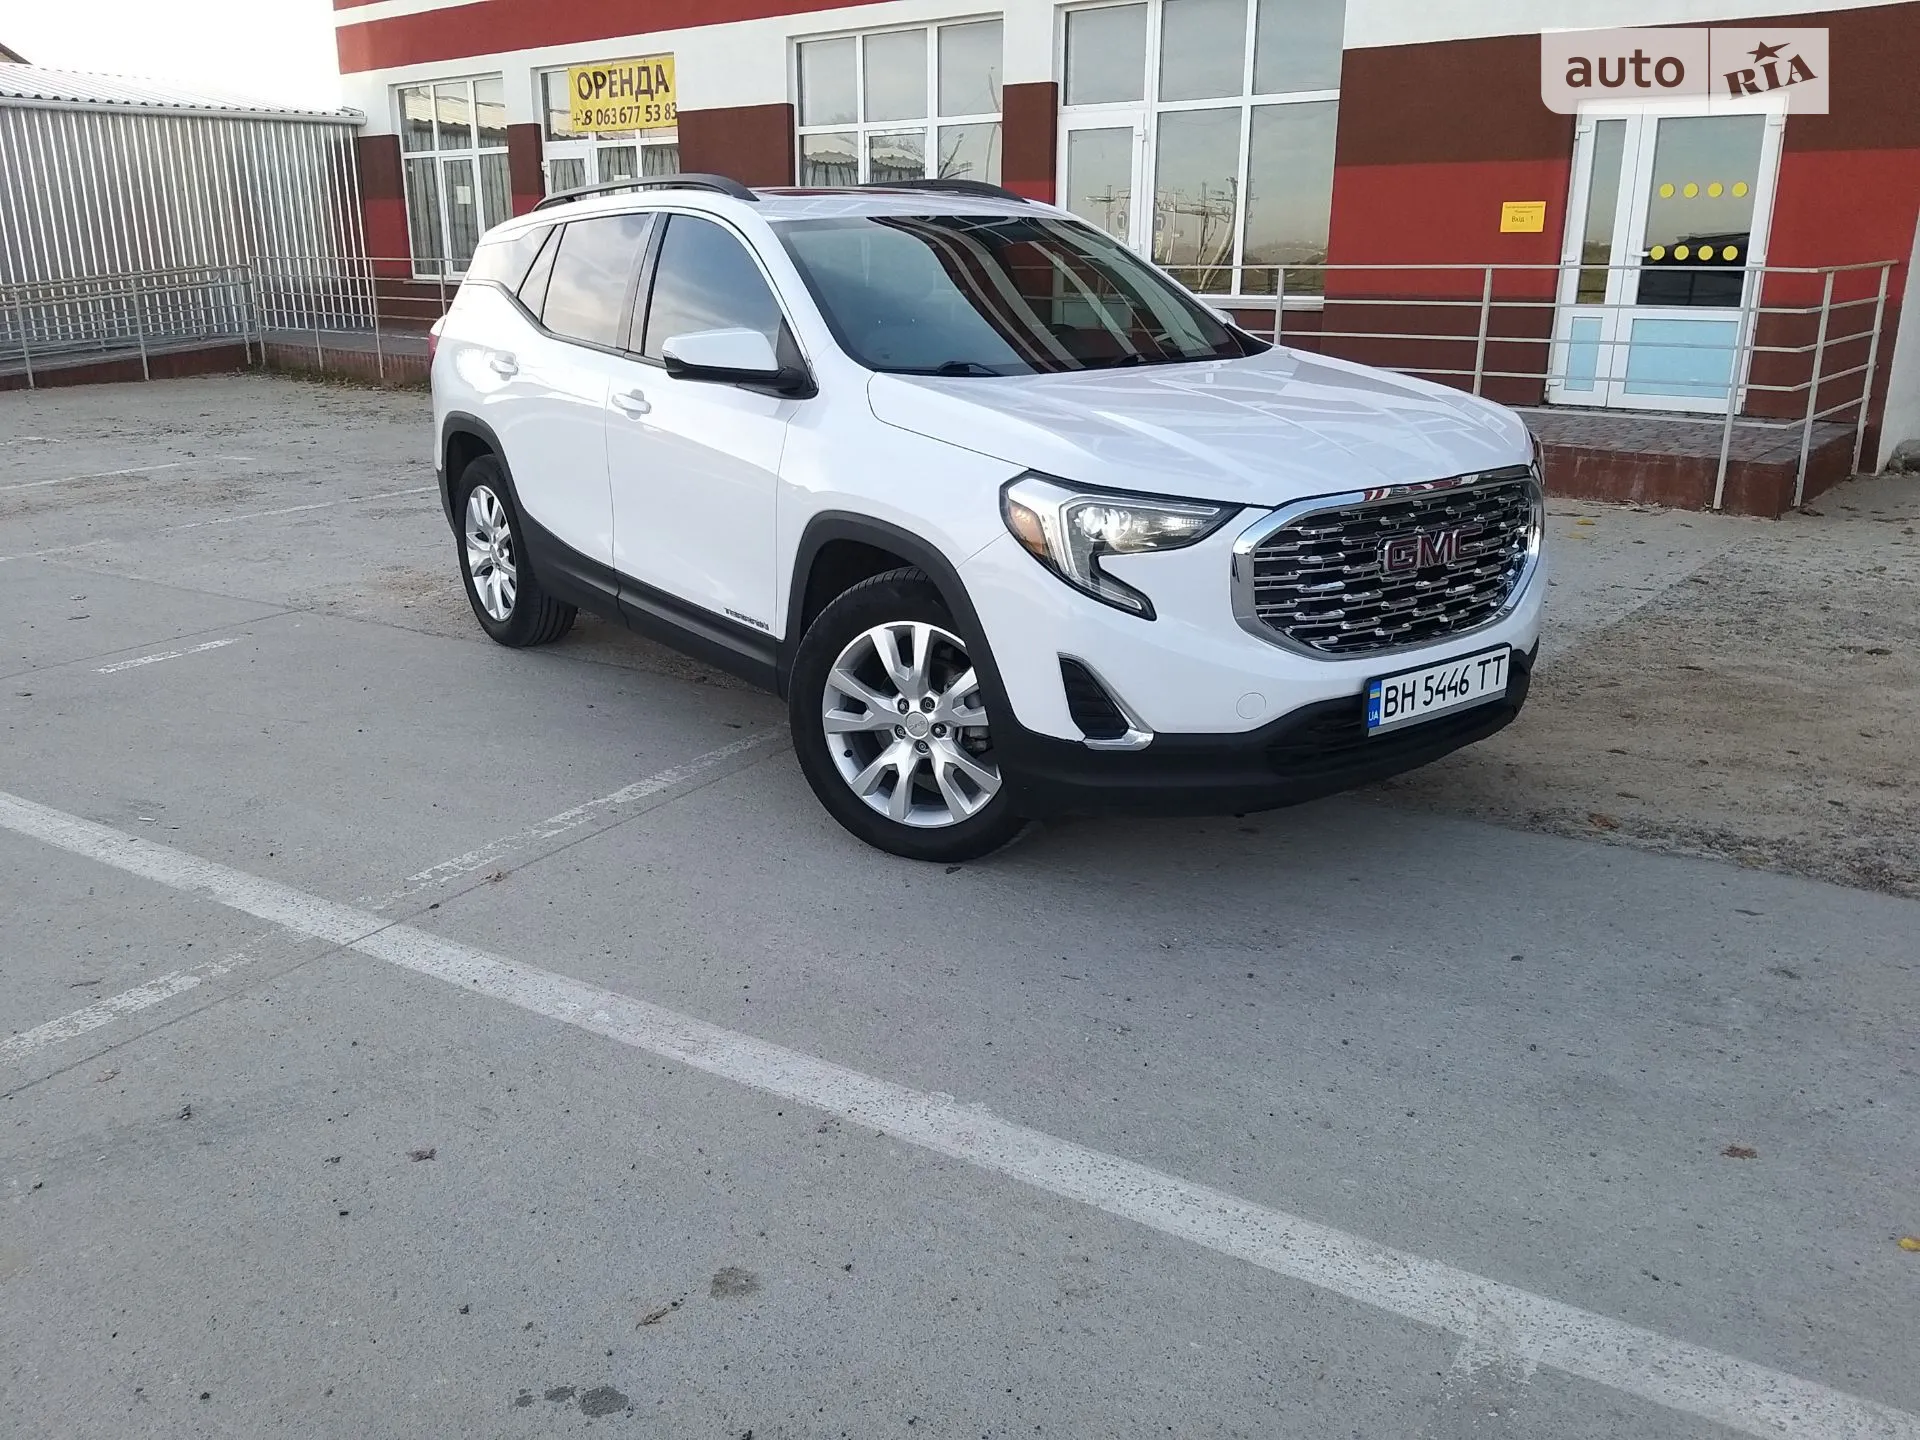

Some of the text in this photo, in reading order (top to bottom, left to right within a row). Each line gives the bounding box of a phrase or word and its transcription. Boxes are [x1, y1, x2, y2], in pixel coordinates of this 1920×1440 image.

[577, 64, 670, 102] ОРЕНДА
[596, 107, 617, 126] 063
[619, 105, 641, 124] 677
[645, 104, 661, 122] 53
[664, 102, 678, 121] 83
[1384, 523, 1484, 572] GMC
[1384, 654, 1507, 718] BH 5446 TT
[1368, 711, 1379, 721] UA
